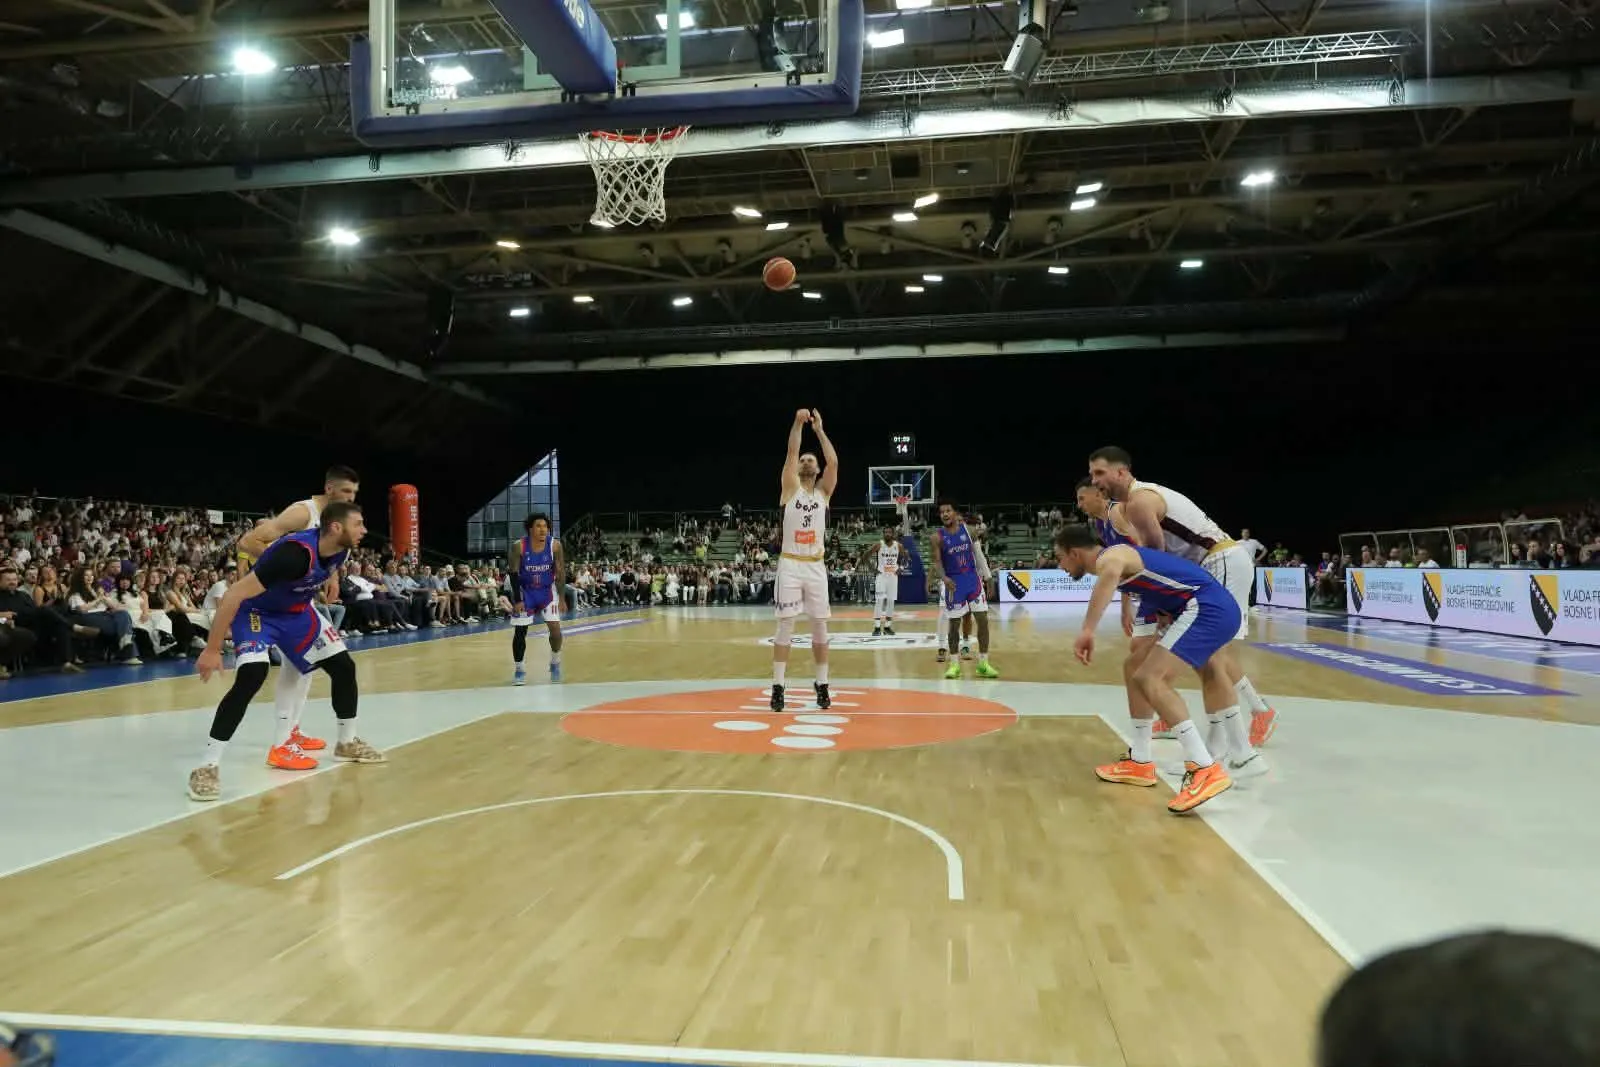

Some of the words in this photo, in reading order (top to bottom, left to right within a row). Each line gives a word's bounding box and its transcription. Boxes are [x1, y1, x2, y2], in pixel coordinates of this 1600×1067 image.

[896, 444, 908, 454] 14
[1563, 589, 1592, 602] VLADA
[1446, 598, 1466, 608] BOSNE
[1563, 605, 1593, 619] BOSNE
